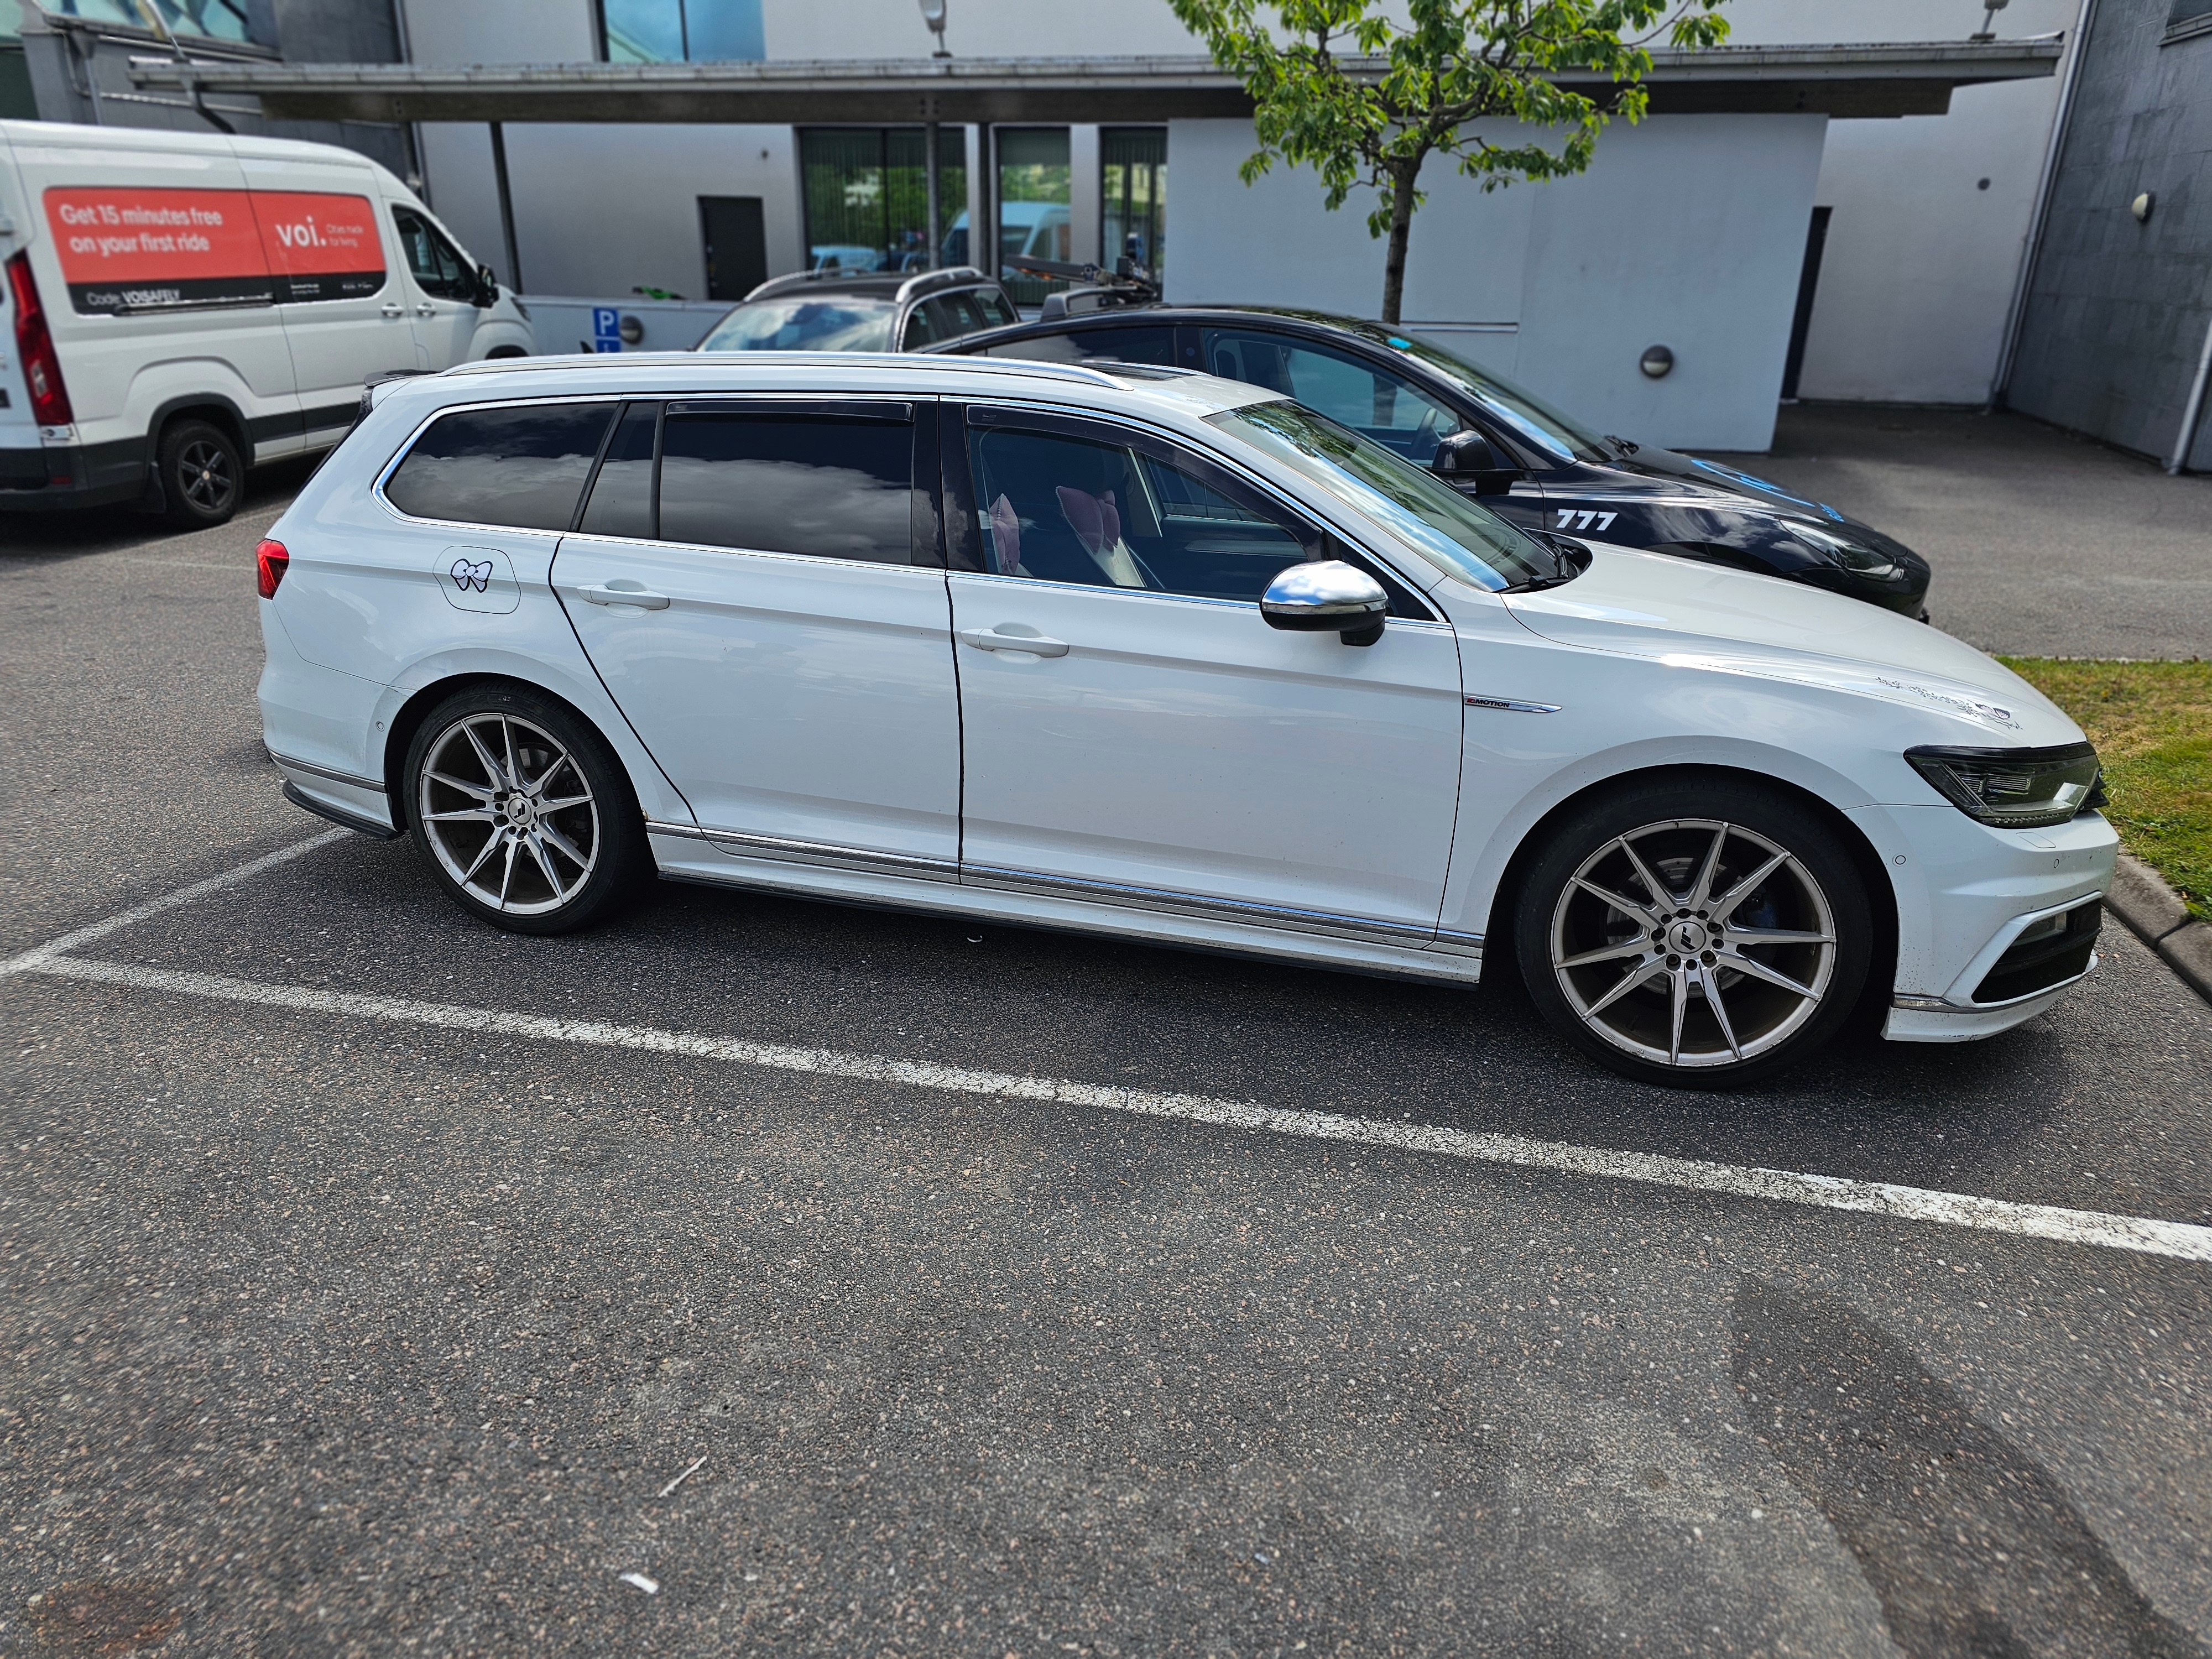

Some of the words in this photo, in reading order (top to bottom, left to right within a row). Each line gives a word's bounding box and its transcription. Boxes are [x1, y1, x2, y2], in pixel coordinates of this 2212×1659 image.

[60, 204, 99, 225] Get
[98, 205, 120, 225] 15
[121, 205, 190, 226] minutes
[191, 207, 223, 226] free
[69, 236, 97, 253] on
[97, 236, 138, 258] your
[140, 232, 176, 252] first
[177, 232, 210, 252] ride
[598, 310, 615, 335] P
[1556, 509, 1619, 531] 777
[1468, 698, 1510, 708] 4MOTION
